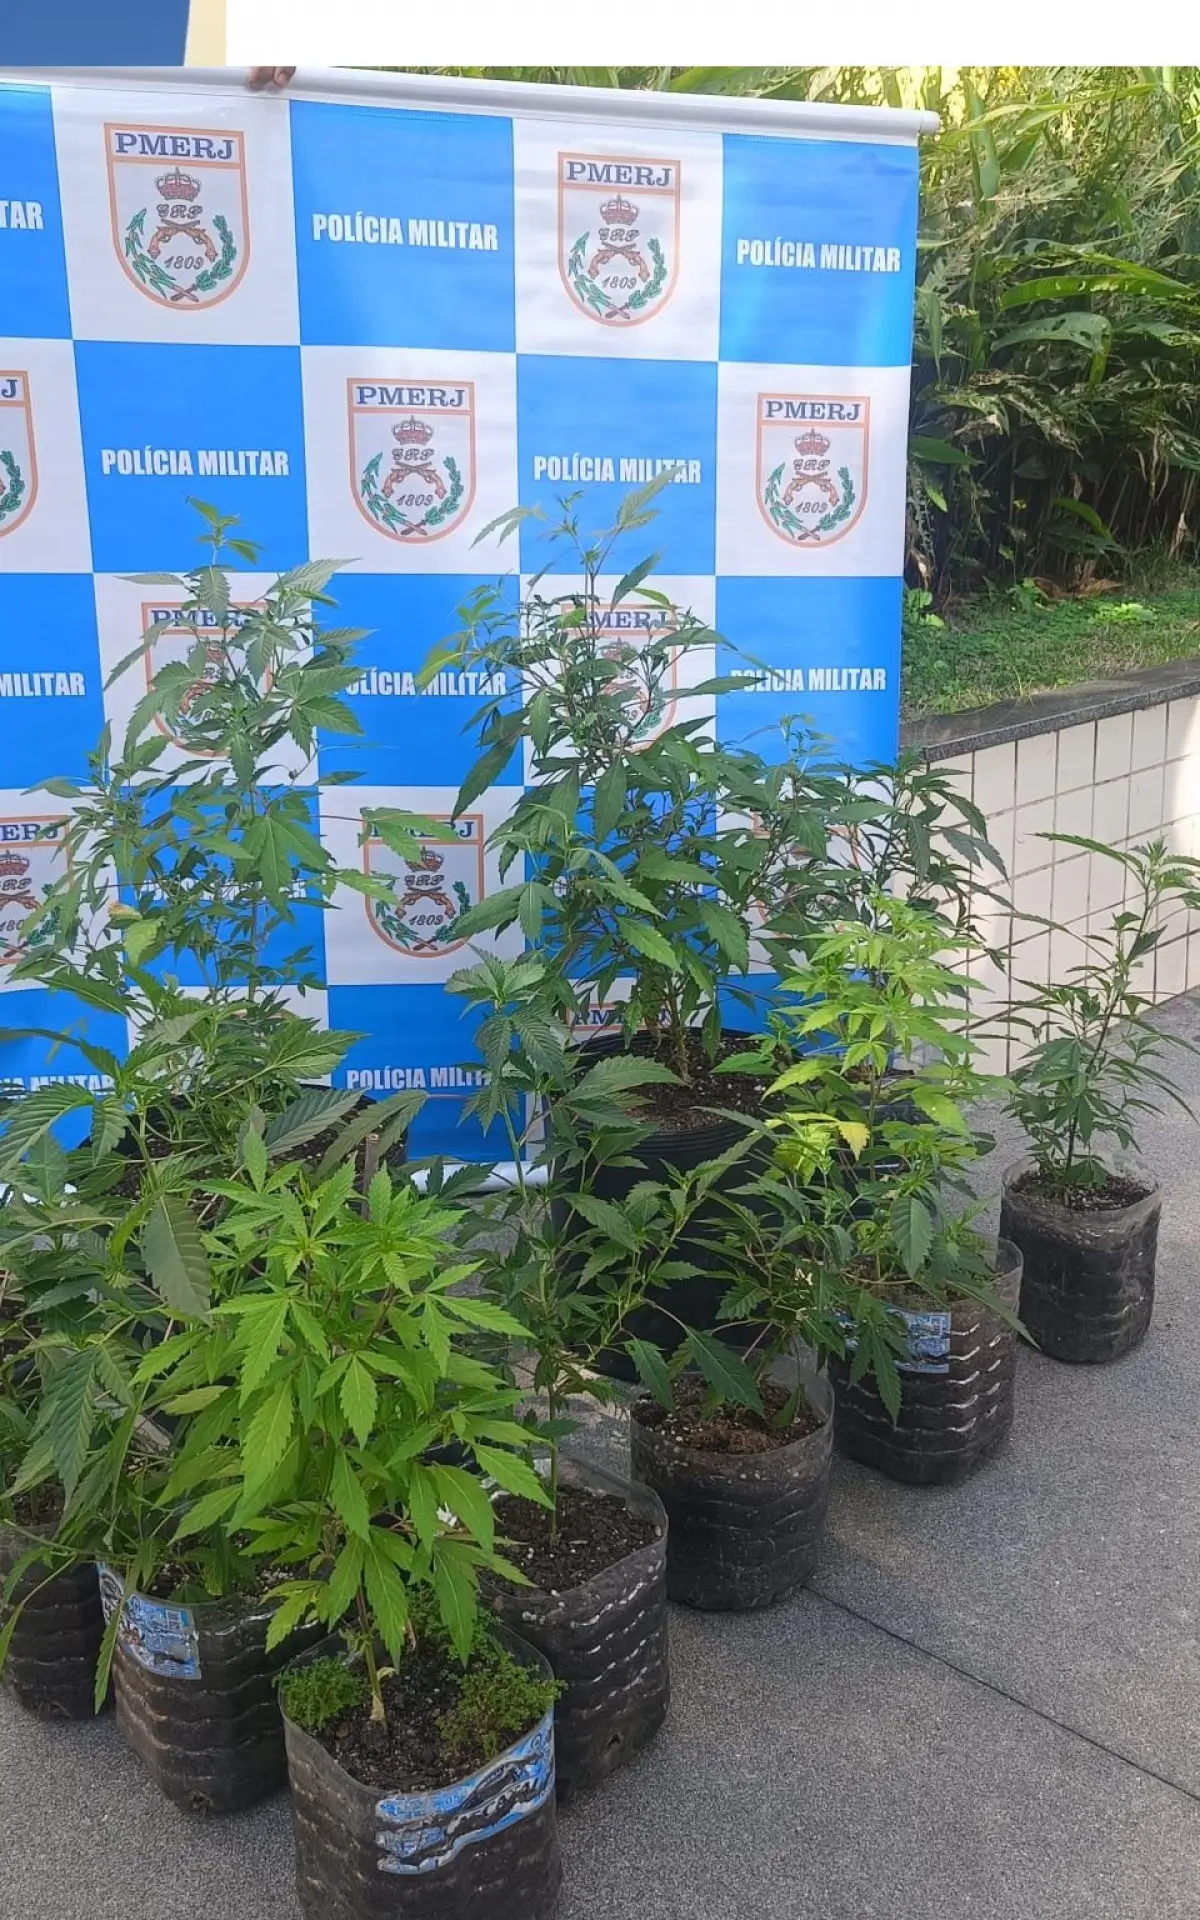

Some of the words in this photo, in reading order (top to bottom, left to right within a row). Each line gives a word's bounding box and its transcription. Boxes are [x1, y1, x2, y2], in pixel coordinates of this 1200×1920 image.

[115, 132, 234, 160] PMERJ
[566, 161, 672, 187] PMERJ
[312, 211, 404, 245] POLÍCIA
[408, 219, 499, 250] MILITAR
[164, 256, 204, 270] 1809
[737, 236, 816, 268] POLÍCIA
[819, 244, 902, 272] MILITAR
[601, 276, 638, 289] 1809
[356, 386, 466, 407] PMERJ
[765, 400, 862, 421] PMERJ
[101, 445, 194, 476] POLÍCIA
[197, 450, 290, 476] MILITAR
[534, 452, 615, 483] POLÍCIA
[619, 458, 701, 484] MILITAR
[396, 494, 434, 507] 1809
[795, 501, 828, 513] 1809
[151, 609, 249, 627] PMER
[588, 611, 667, 629] MERJ
[808, 668, 887, 691] MILITAR
[409, 915, 444, 926] 1809
[346, 1065, 425, 1090] POLÍCIA
